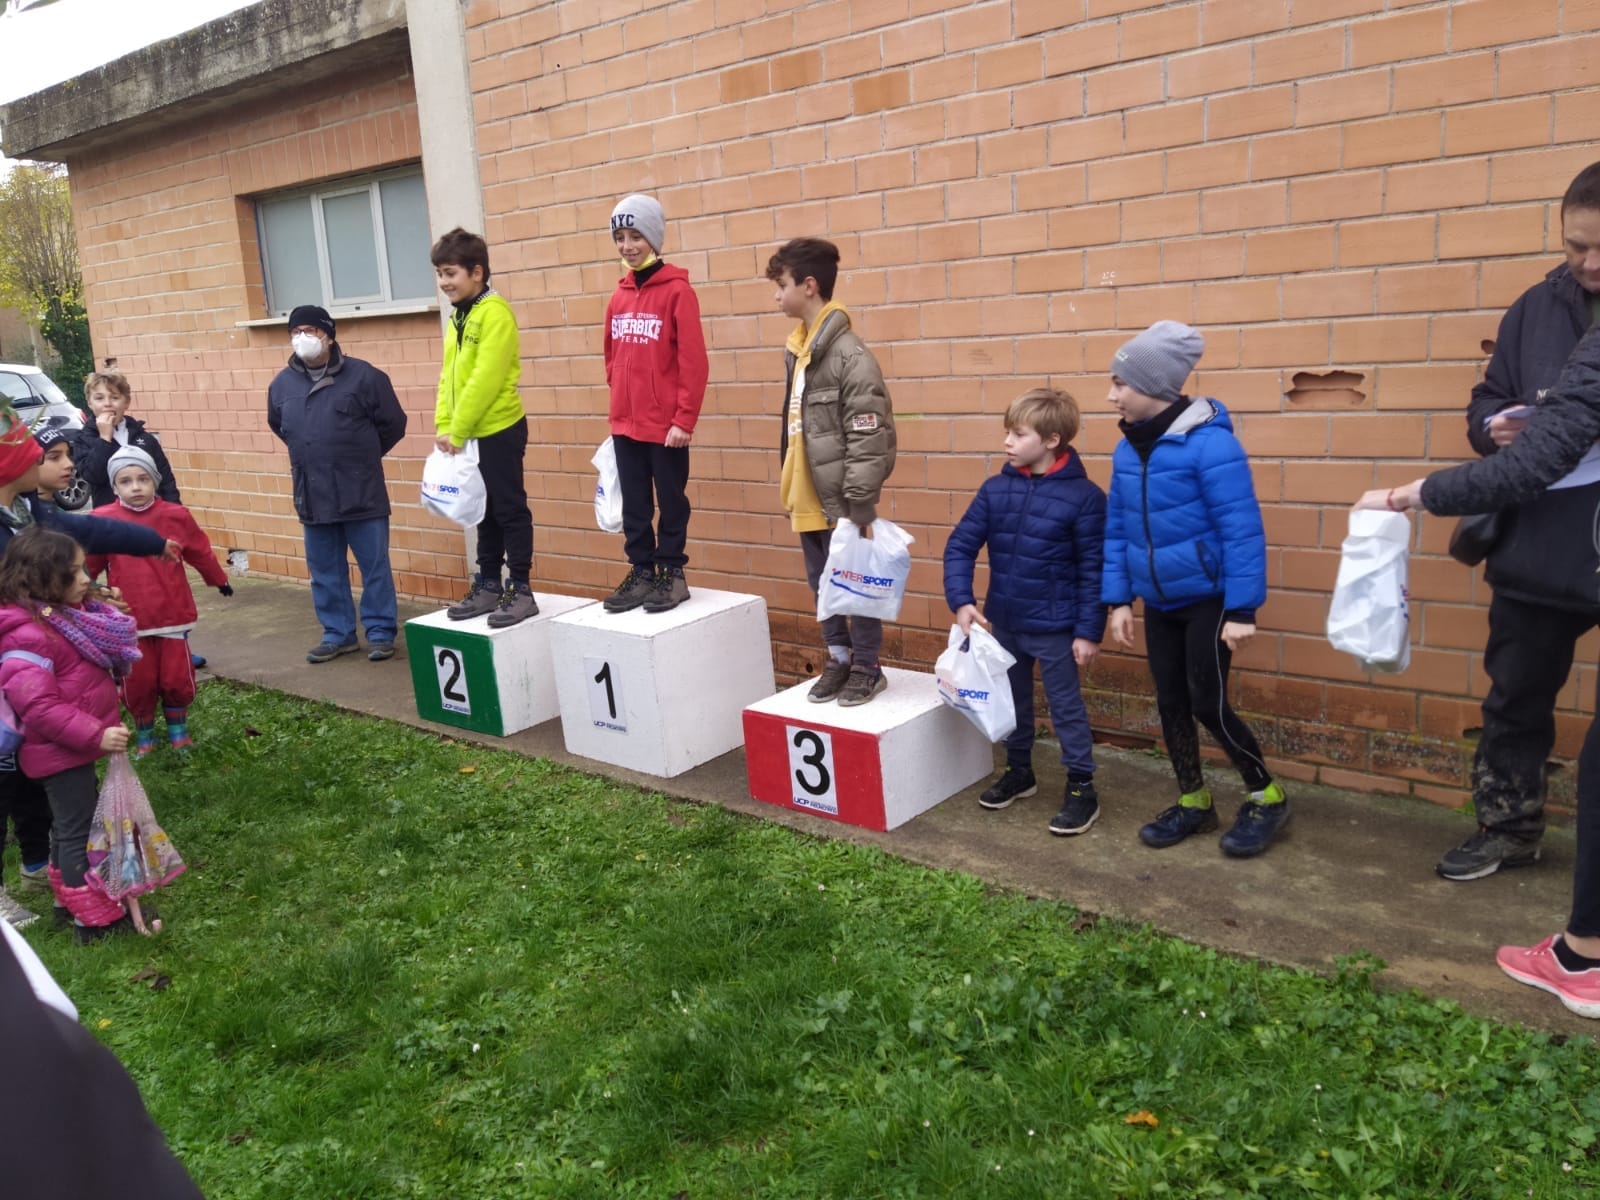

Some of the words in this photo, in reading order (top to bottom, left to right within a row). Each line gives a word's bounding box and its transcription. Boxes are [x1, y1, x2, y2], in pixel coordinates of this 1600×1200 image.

[611, 214, 635, 229] NYC
[621, 335, 649, 345] TEAM
[438, 649, 466, 703] 2
[594, 661, 617, 720] 1
[793, 730, 831, 796] 3
